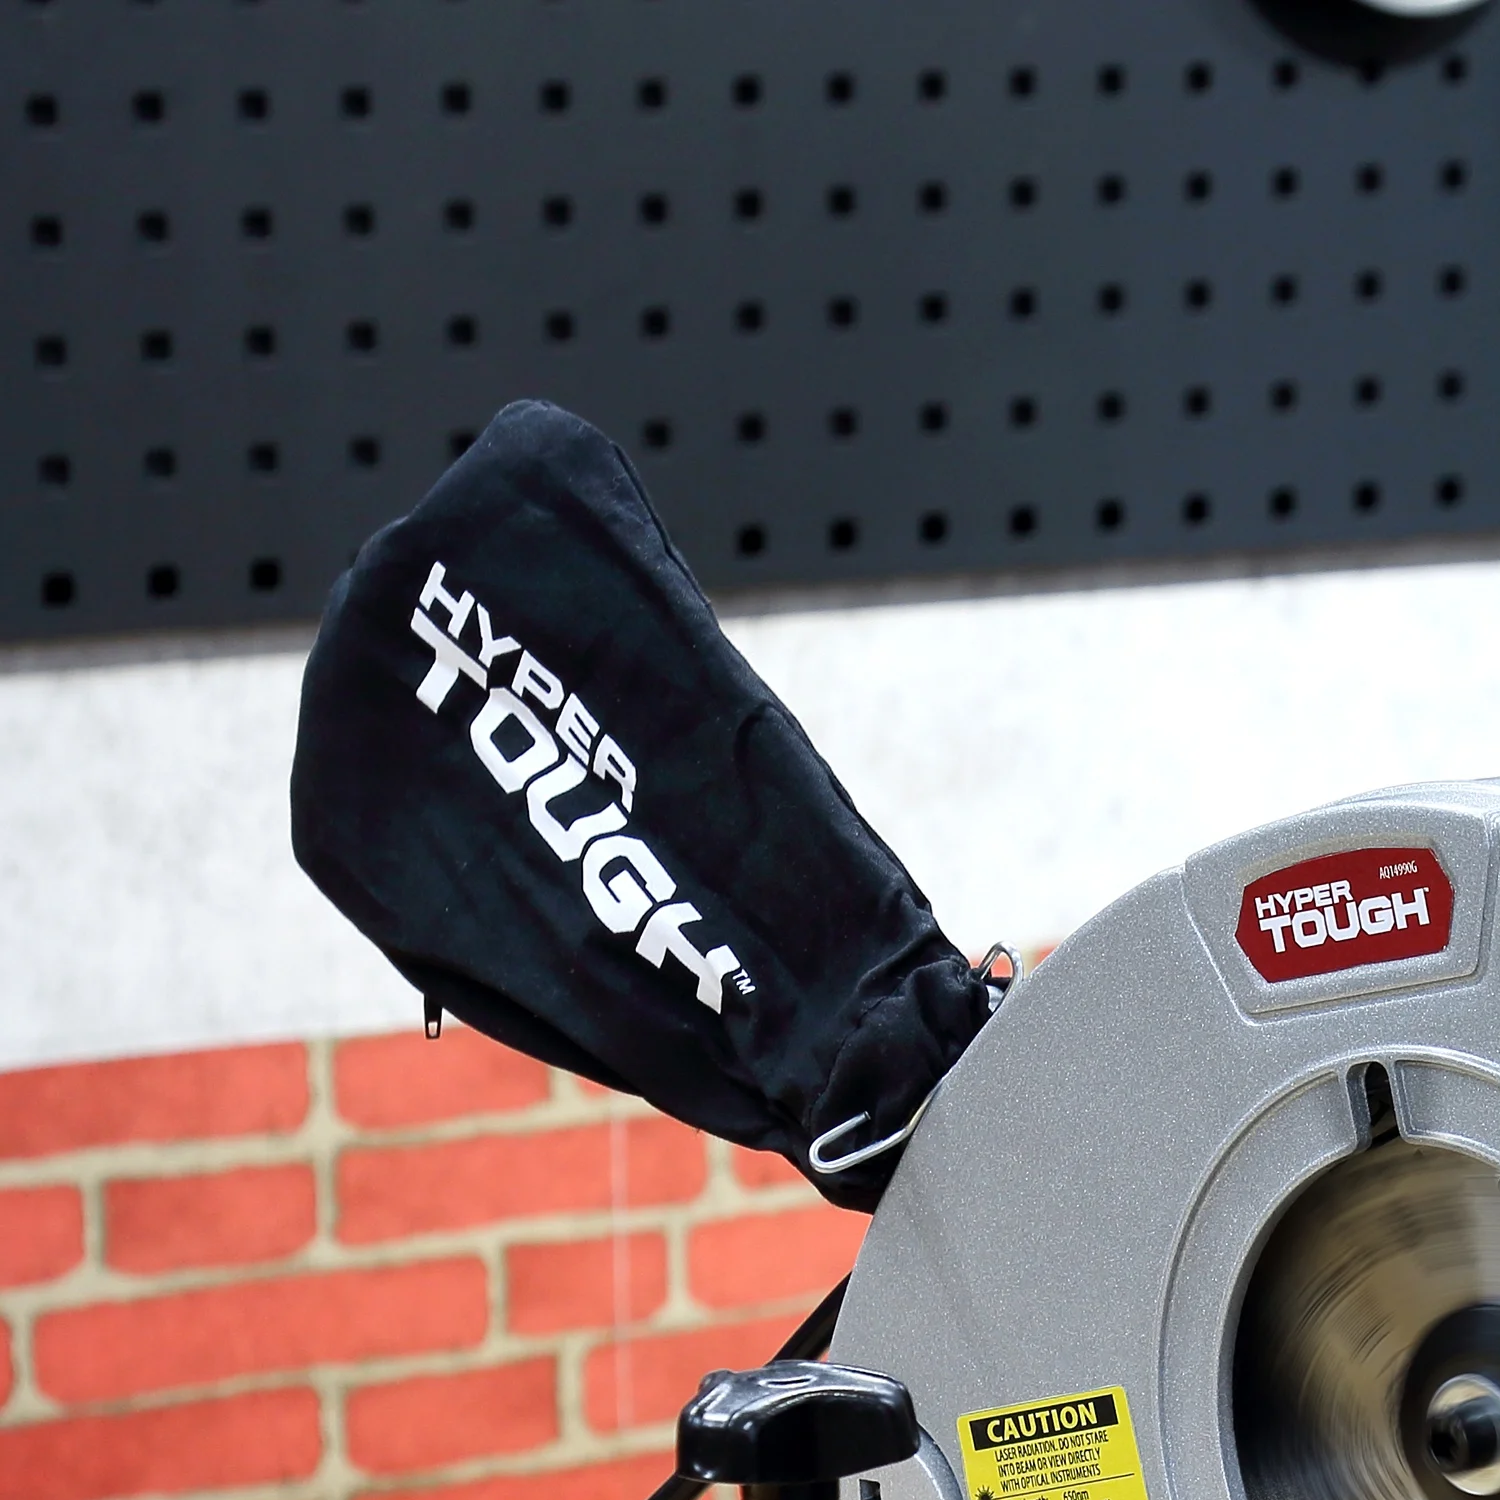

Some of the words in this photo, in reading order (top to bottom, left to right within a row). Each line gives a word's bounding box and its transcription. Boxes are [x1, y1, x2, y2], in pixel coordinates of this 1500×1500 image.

[419, 560, 638, 813] HYPER
[410, 607, 741, 1015] TOUGH
[1379, 859, 1418, 880] AQ14990G
[1255, 879, 1354, 919] HYPER
[1258, 887, 1431, 953] TOUGH
[986, 1401, 1098, 1443] CAUTION
[994, 1447, 1017, 1462] LASER
[1017, 1439, 1058, 1457] RADIATION.
[1058, 1437, 1069, 1451] DO
[1069, 1433, 1085, 1448] NOT
[1085, 1430, 1109, 1445] STARE
[998, 1463, 1015, 1477] INTO
[1016, 1459, 1037, 1474] BEAM
[1037, 1457, 1048, 1471] OR
[1047, 1453, 1067, 1468] VIEW
[1067, 1447, 1101, 1465] DIRECTLY
[1000, 1478, 1021, 1493] WITH
[1021, 1473, 1050, 1489] OPTICAL
[1050, 1463, 1101, 1483] INSTRUMENTS
